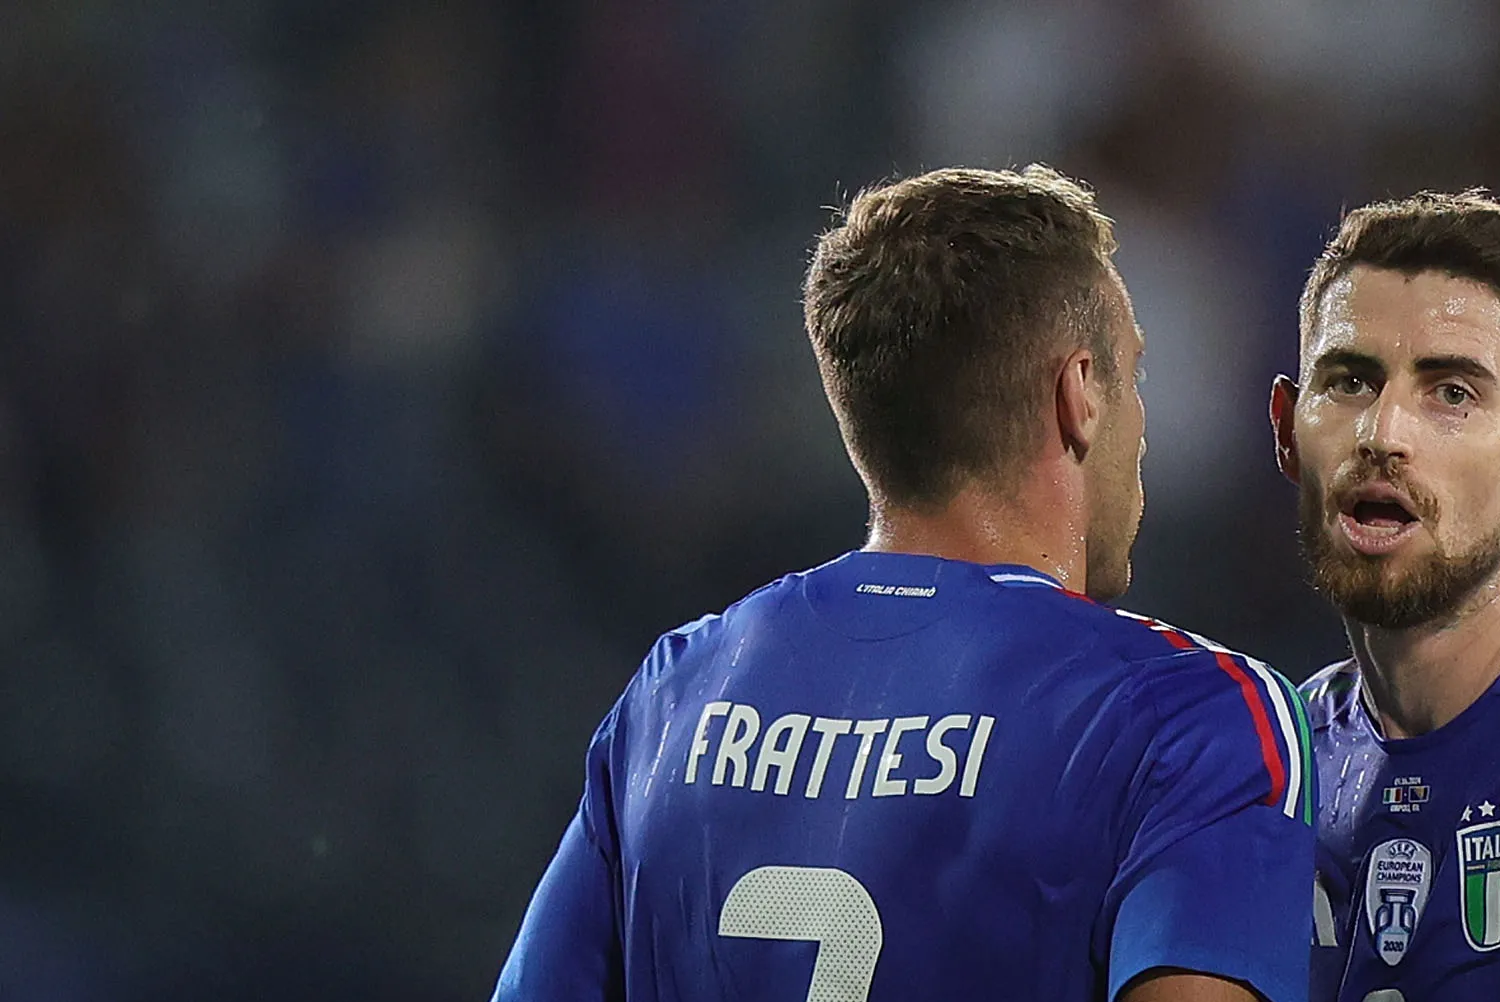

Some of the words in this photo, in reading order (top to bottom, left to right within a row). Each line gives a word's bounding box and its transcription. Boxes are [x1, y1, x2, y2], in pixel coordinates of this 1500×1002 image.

[685, 701, 995, 799] FRATTESI
[1389, 842, 1415, 857] UEFA
[1377, 860, 1425, 872] EUROPEAN
[1377, 873, 1423, 883] CHAMPIONS
[1383, 940, 1405, 952] 2020
